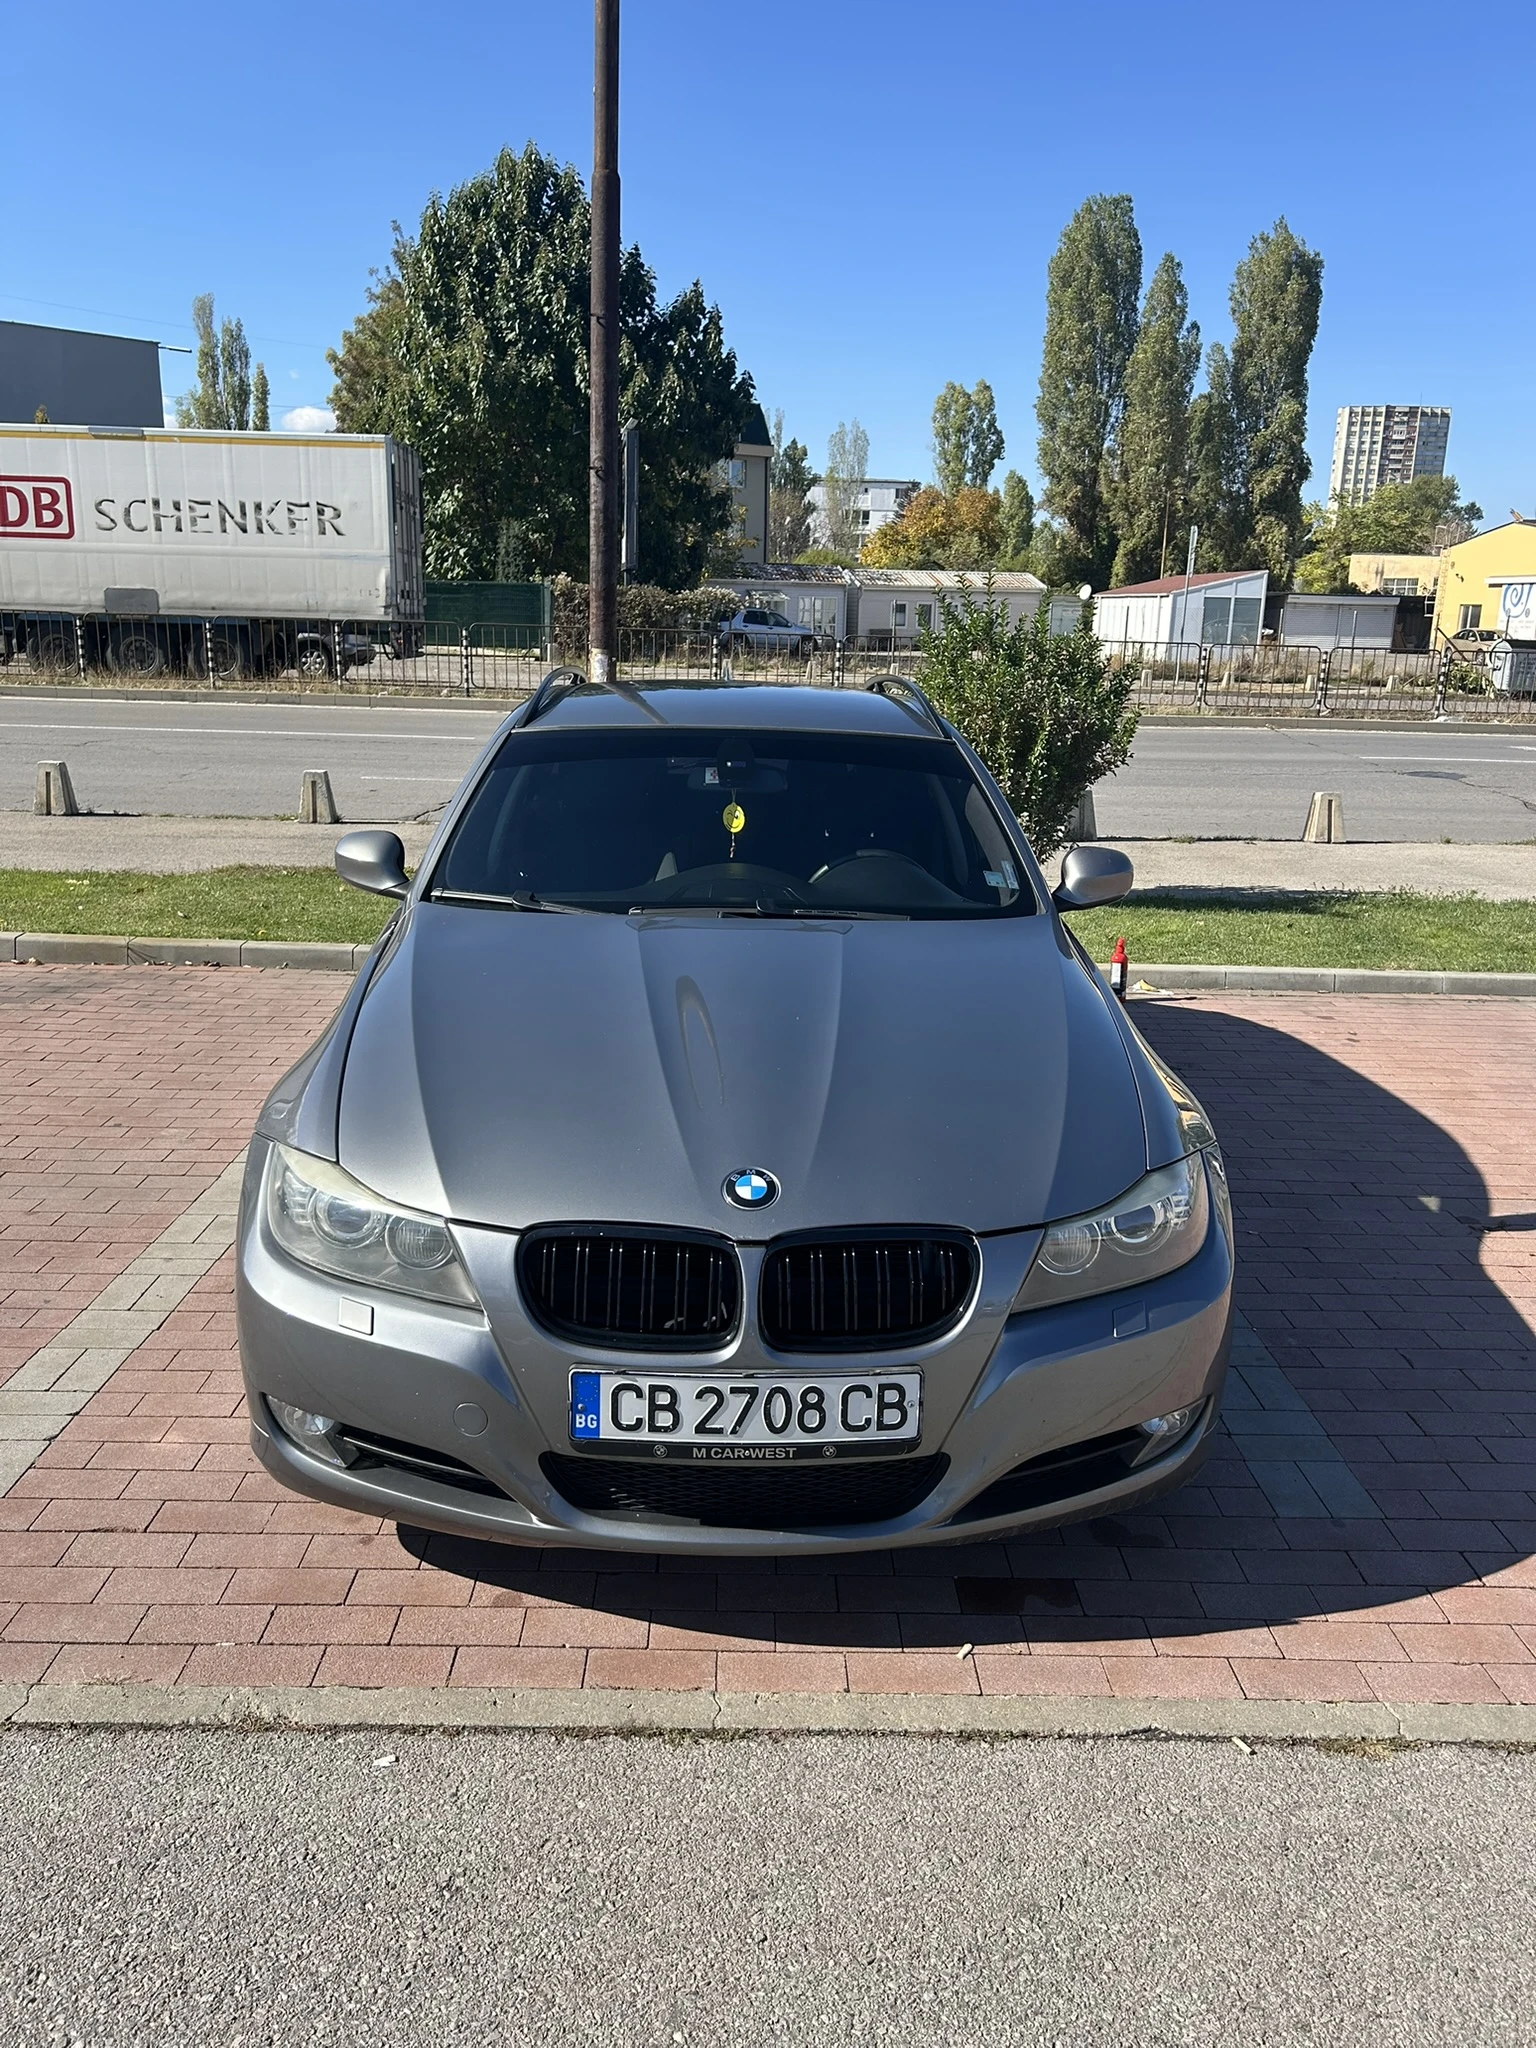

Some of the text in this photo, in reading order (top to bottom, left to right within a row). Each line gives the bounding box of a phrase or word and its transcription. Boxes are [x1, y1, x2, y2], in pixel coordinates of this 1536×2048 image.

[0, 486, 346, 536] DB SCHENKER
[730, 1169, 773, 1182] BMW
[611, 1383, 908, 1435] CB 2708 CB
[575, 1414, 598, 1428] BG
[693, 1447, 707, 1458] M
